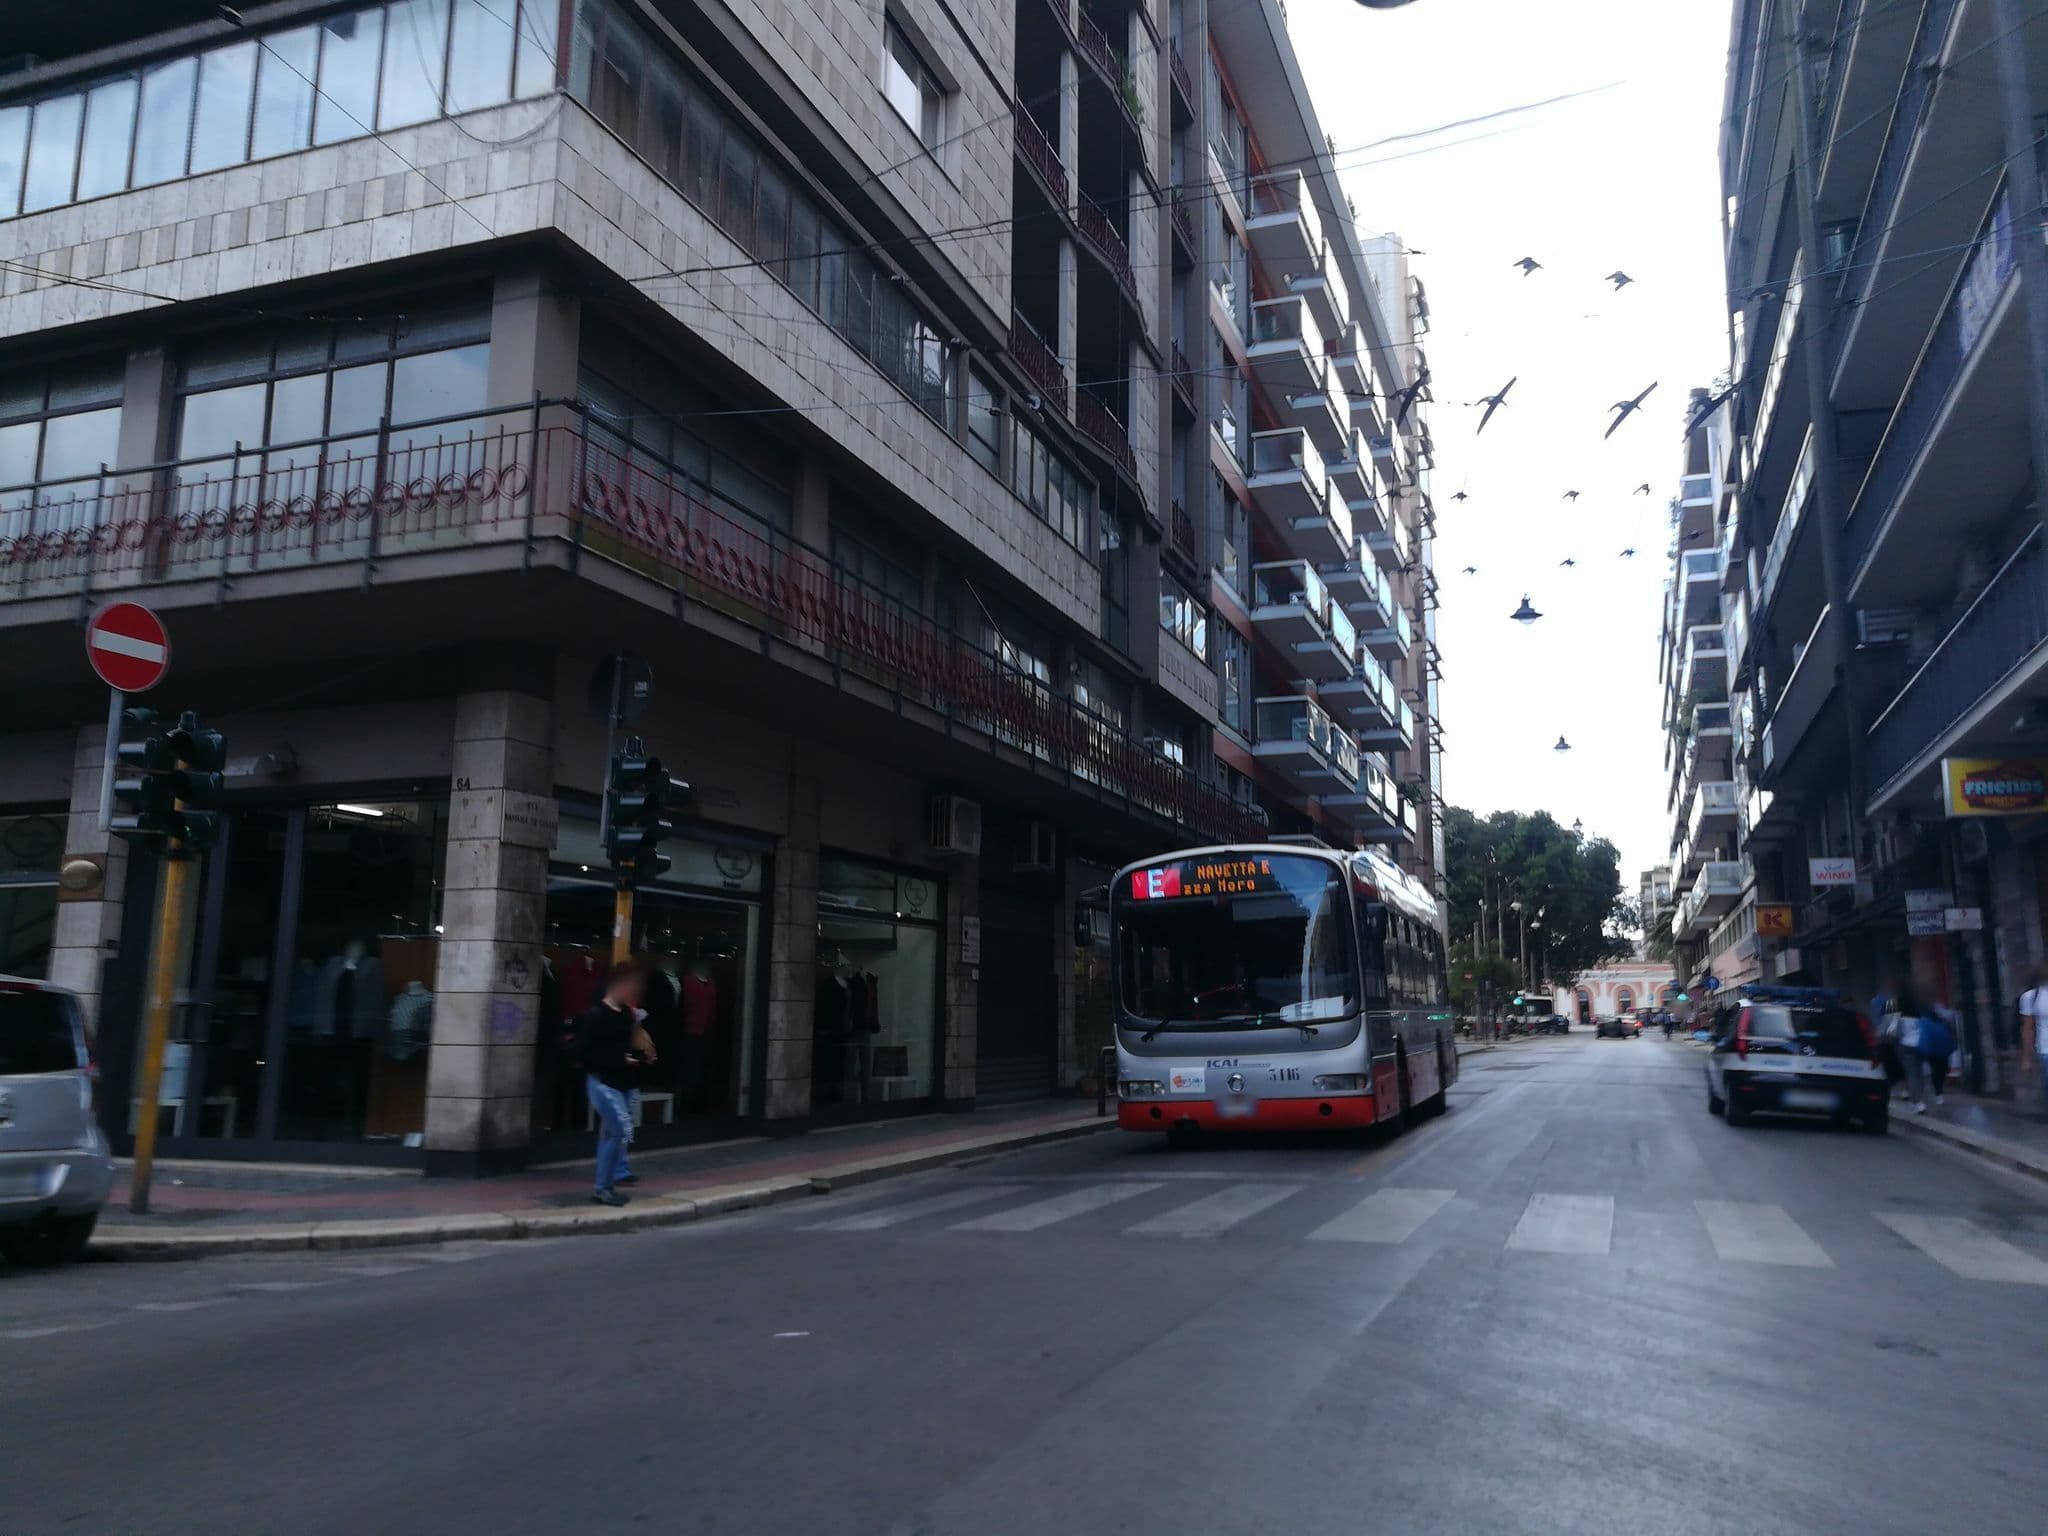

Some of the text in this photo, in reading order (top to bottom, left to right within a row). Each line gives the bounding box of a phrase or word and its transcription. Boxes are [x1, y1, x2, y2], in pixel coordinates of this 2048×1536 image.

[1197, 860, 1256, 880] NAVETTA
[1148, 869, 1165, 898] E
[1218, 879, 1256, 893] Moro
